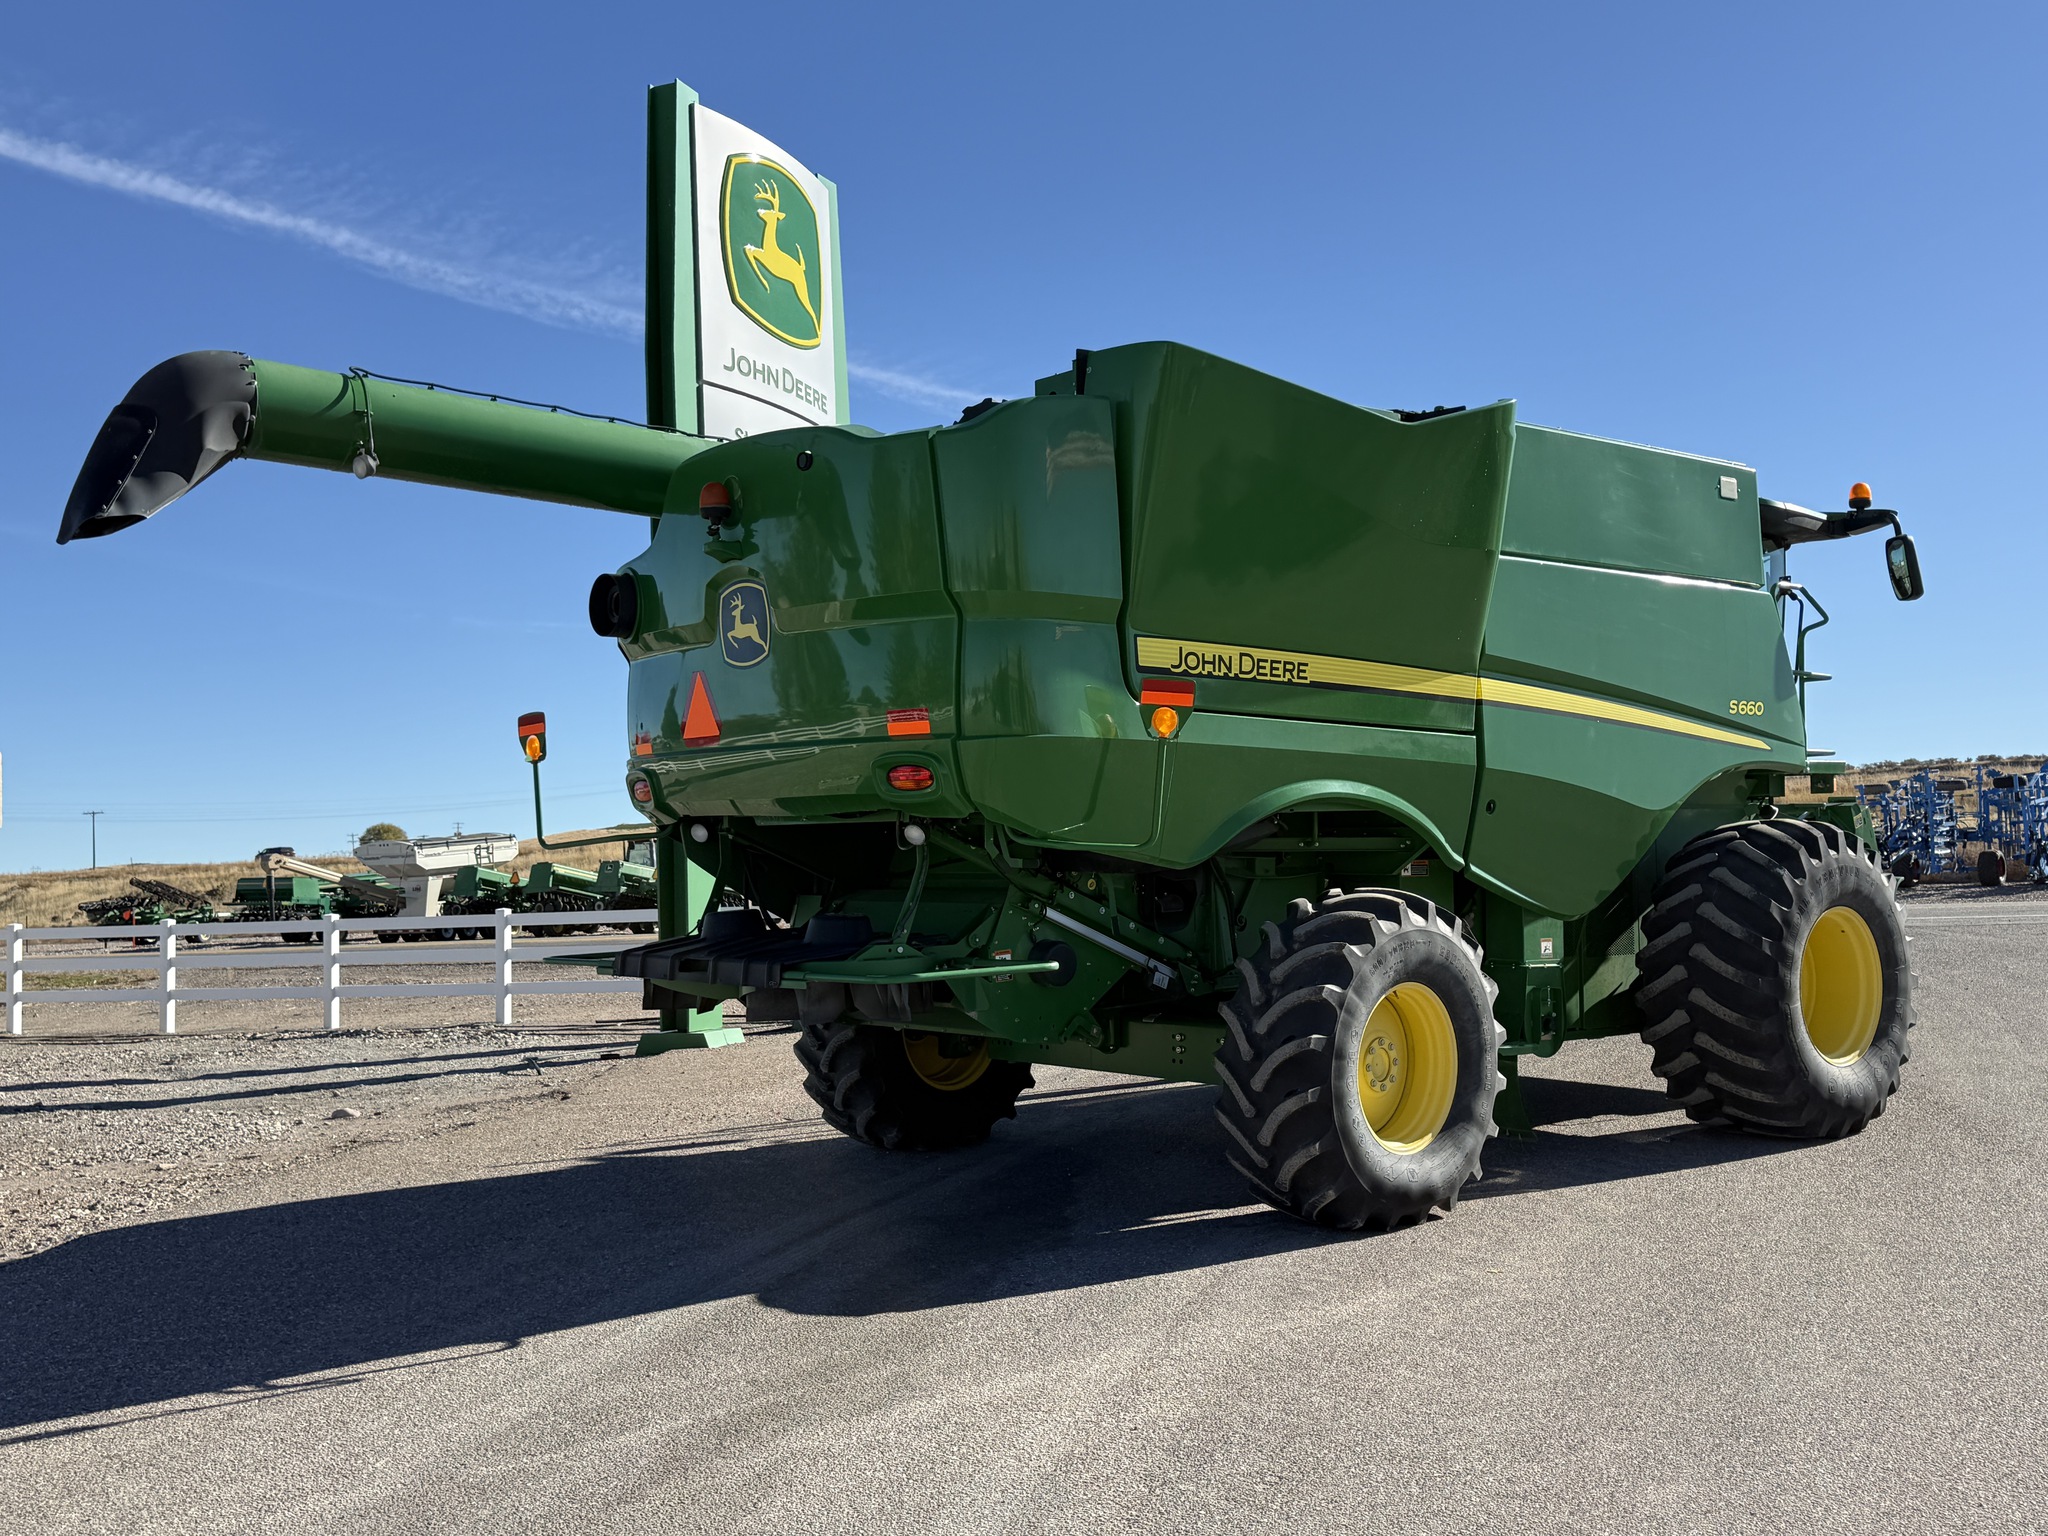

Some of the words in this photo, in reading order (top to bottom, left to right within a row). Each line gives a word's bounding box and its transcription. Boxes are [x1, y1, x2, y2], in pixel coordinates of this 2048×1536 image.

[723, 347, 779, 389] JOHN
[782, 367, 828, 415] DEERE
[1170, 646, 1233, 674] JOHN
[1238, 652, 1309, 681] DEERE
[1728, 699, 1765, 716] S660
